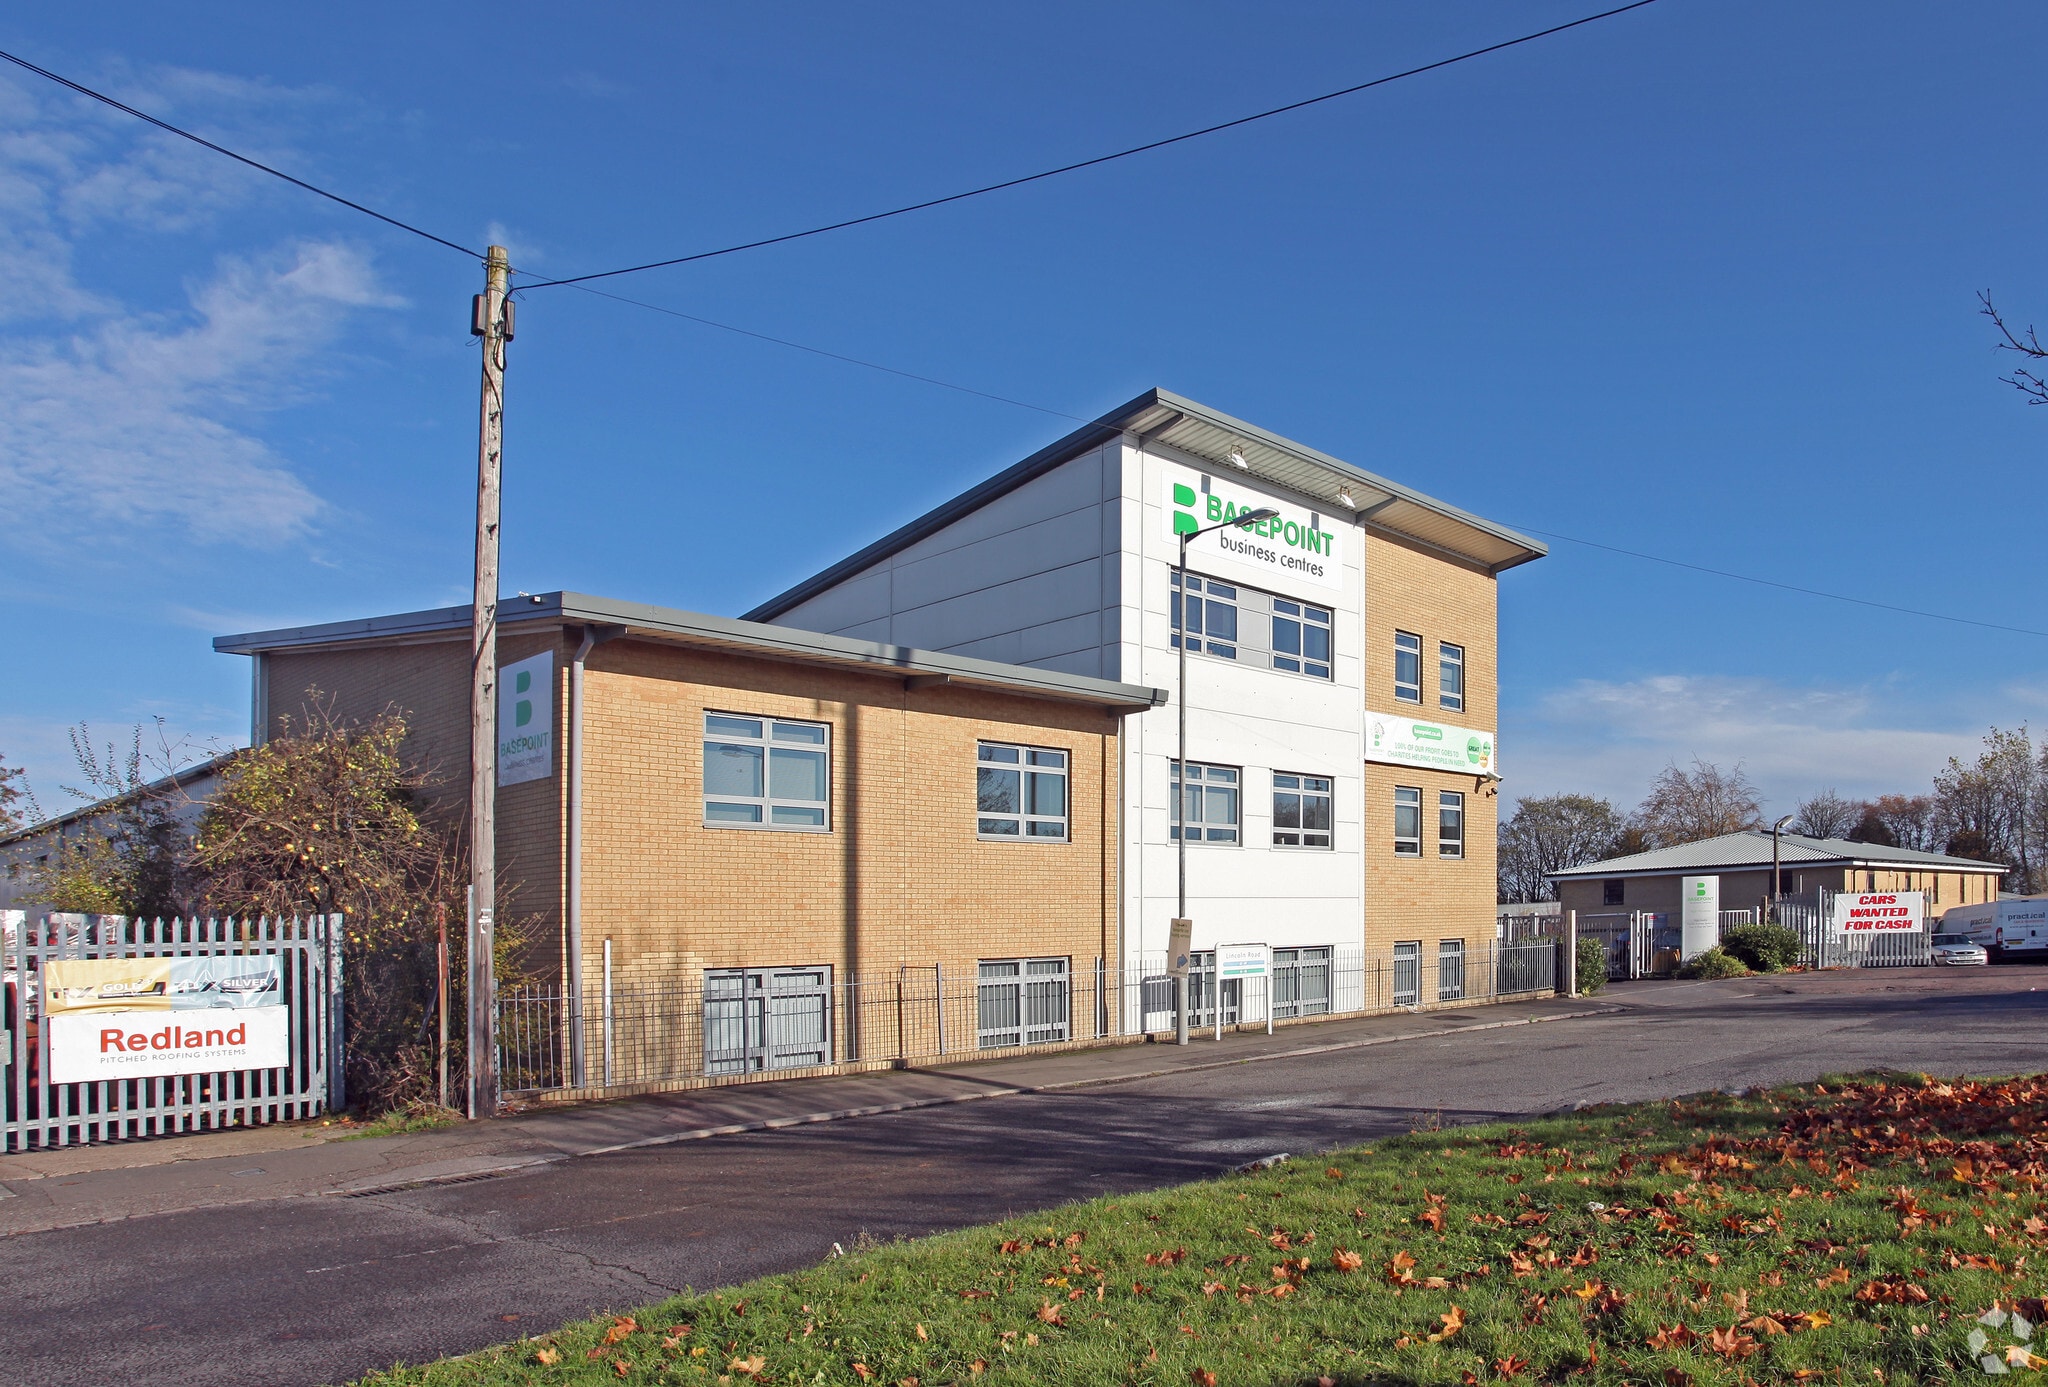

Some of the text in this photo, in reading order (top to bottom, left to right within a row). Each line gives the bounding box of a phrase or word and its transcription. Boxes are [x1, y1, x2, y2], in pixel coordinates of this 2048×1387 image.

[1207, 494, 1334, 556] BASEPOINT
[1220, 529, 1324, 577] business centres
[501, 732, 549, 757] BASEPOINT
[1858, 895, 1897, 905] CARS
[1850, 907, 1908, 918] WANTED
[1844, 919, 1913, 931] FOR CASH
[1225, 951, 1246, 959] Lincoln
[223, 978, 268, 987] SILVER
[100, 1022, 246, 1053] Redland
[100, 1049, 247, 1064] PITCHED ROOFING SYSTEMS
